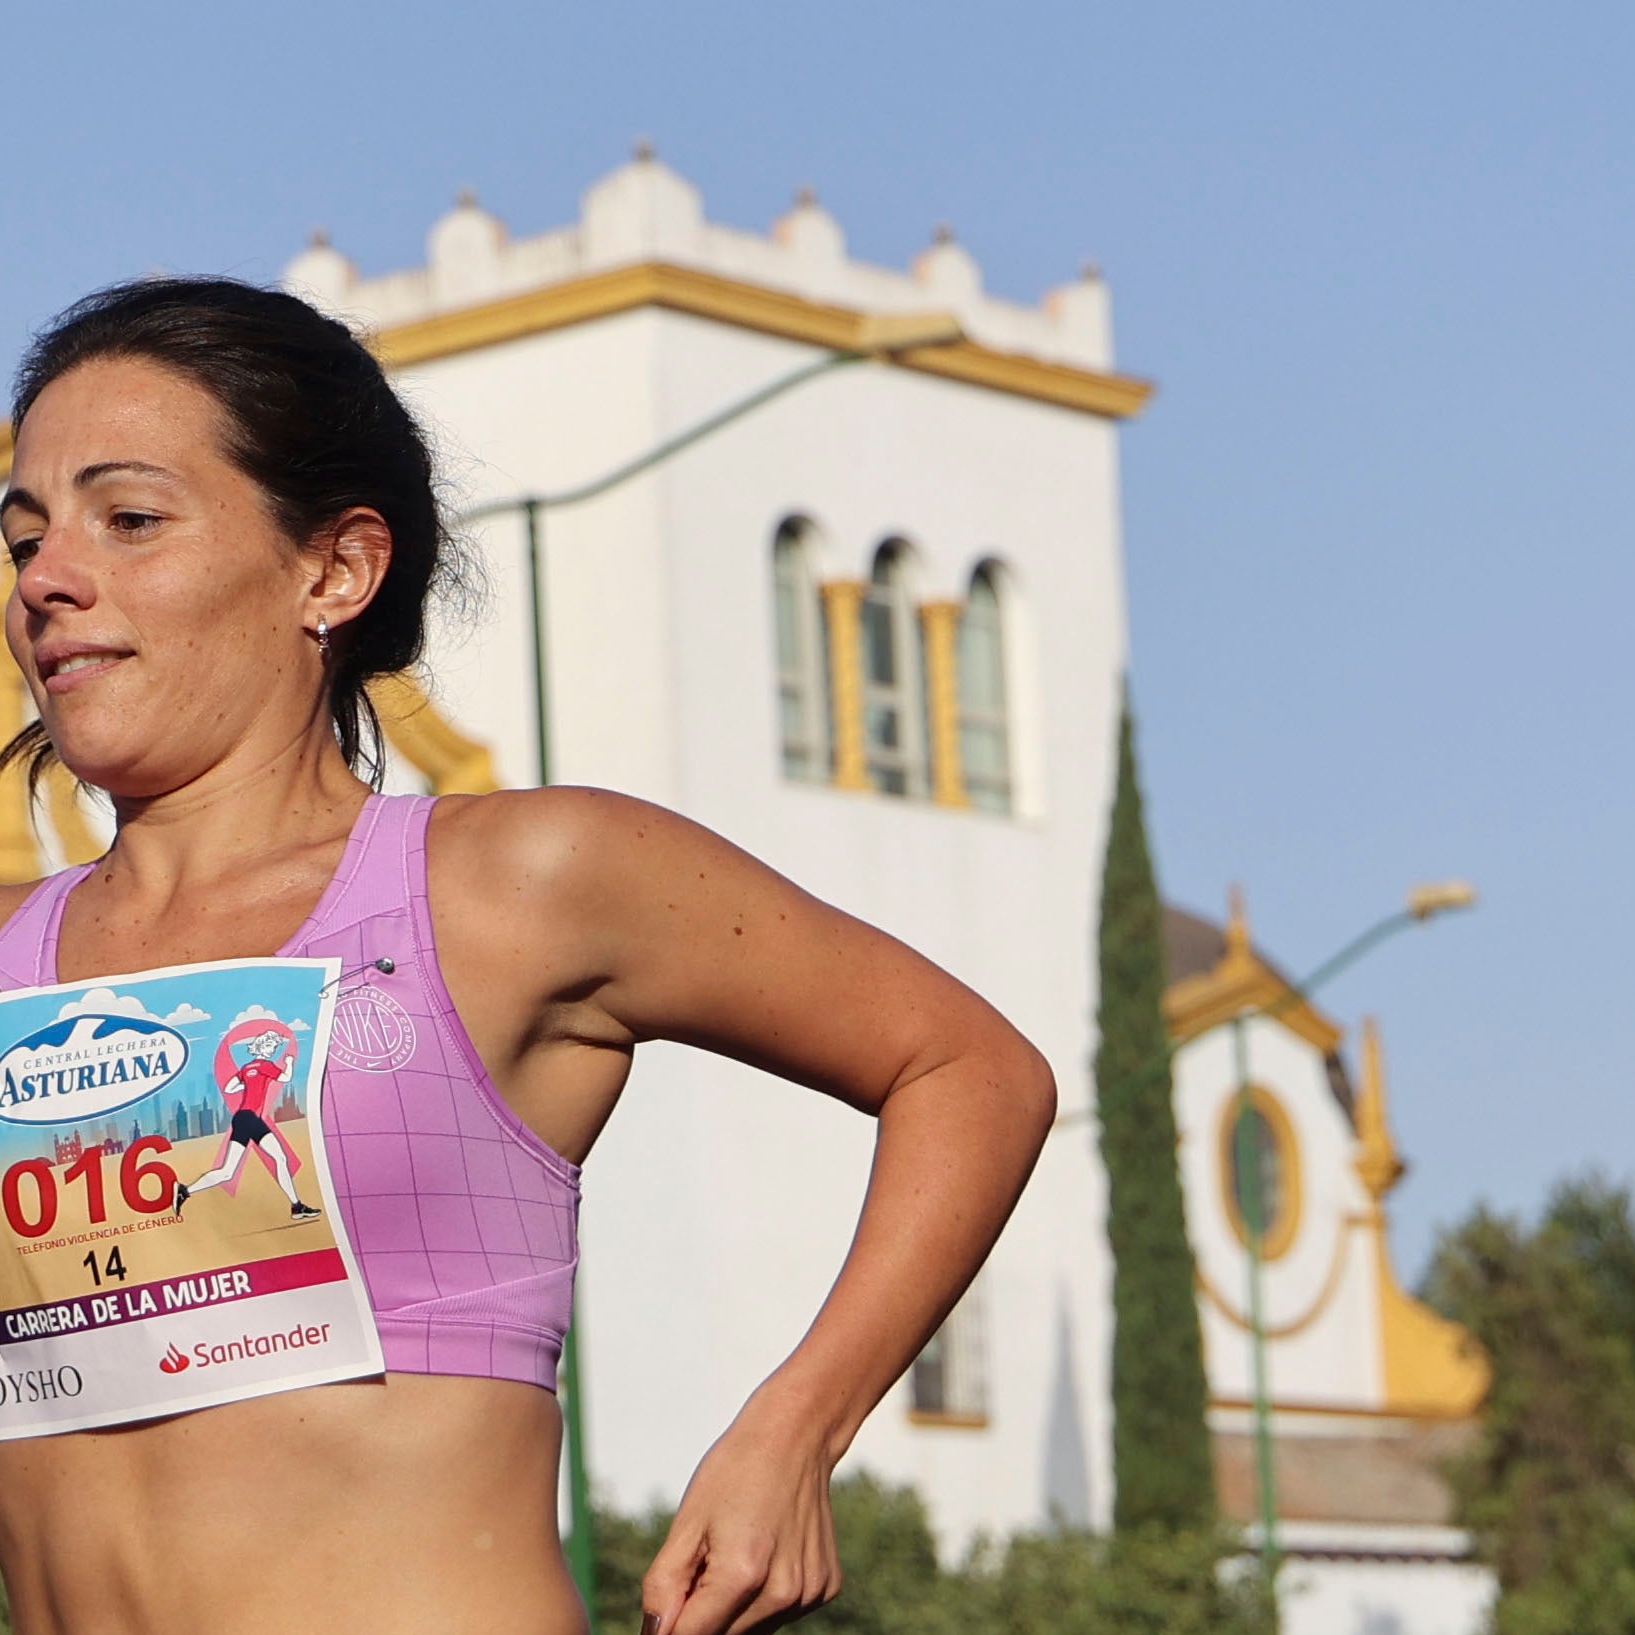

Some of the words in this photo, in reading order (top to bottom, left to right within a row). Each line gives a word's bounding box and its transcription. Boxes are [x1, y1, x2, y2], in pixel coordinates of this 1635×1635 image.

[333, 1001, 397, 1054] NIKE
[23, 1051, 91, 1070] CENTRAL
[96, 1037, 167, 1056] LECHERA
[1, 1134, 179, 1239] 016
[17, 1238, 67, 1256] TELÉFONO
[67, 1227, 121, 1246] VIOLENCIA
[122, 1223, 135, 1235] DE
[138, 1213, 185, 1232] GÉNERO
[83, 1245, 128, 1287] 14
[5, 1303, 89, 1339] CARRERA
[92, 1295, 122, 1324] DE
[126, 1289, 157, 1317] LA
[162, 1270, 252, 1310] MUJER
[194, 1323, 330, 1368] Santander
